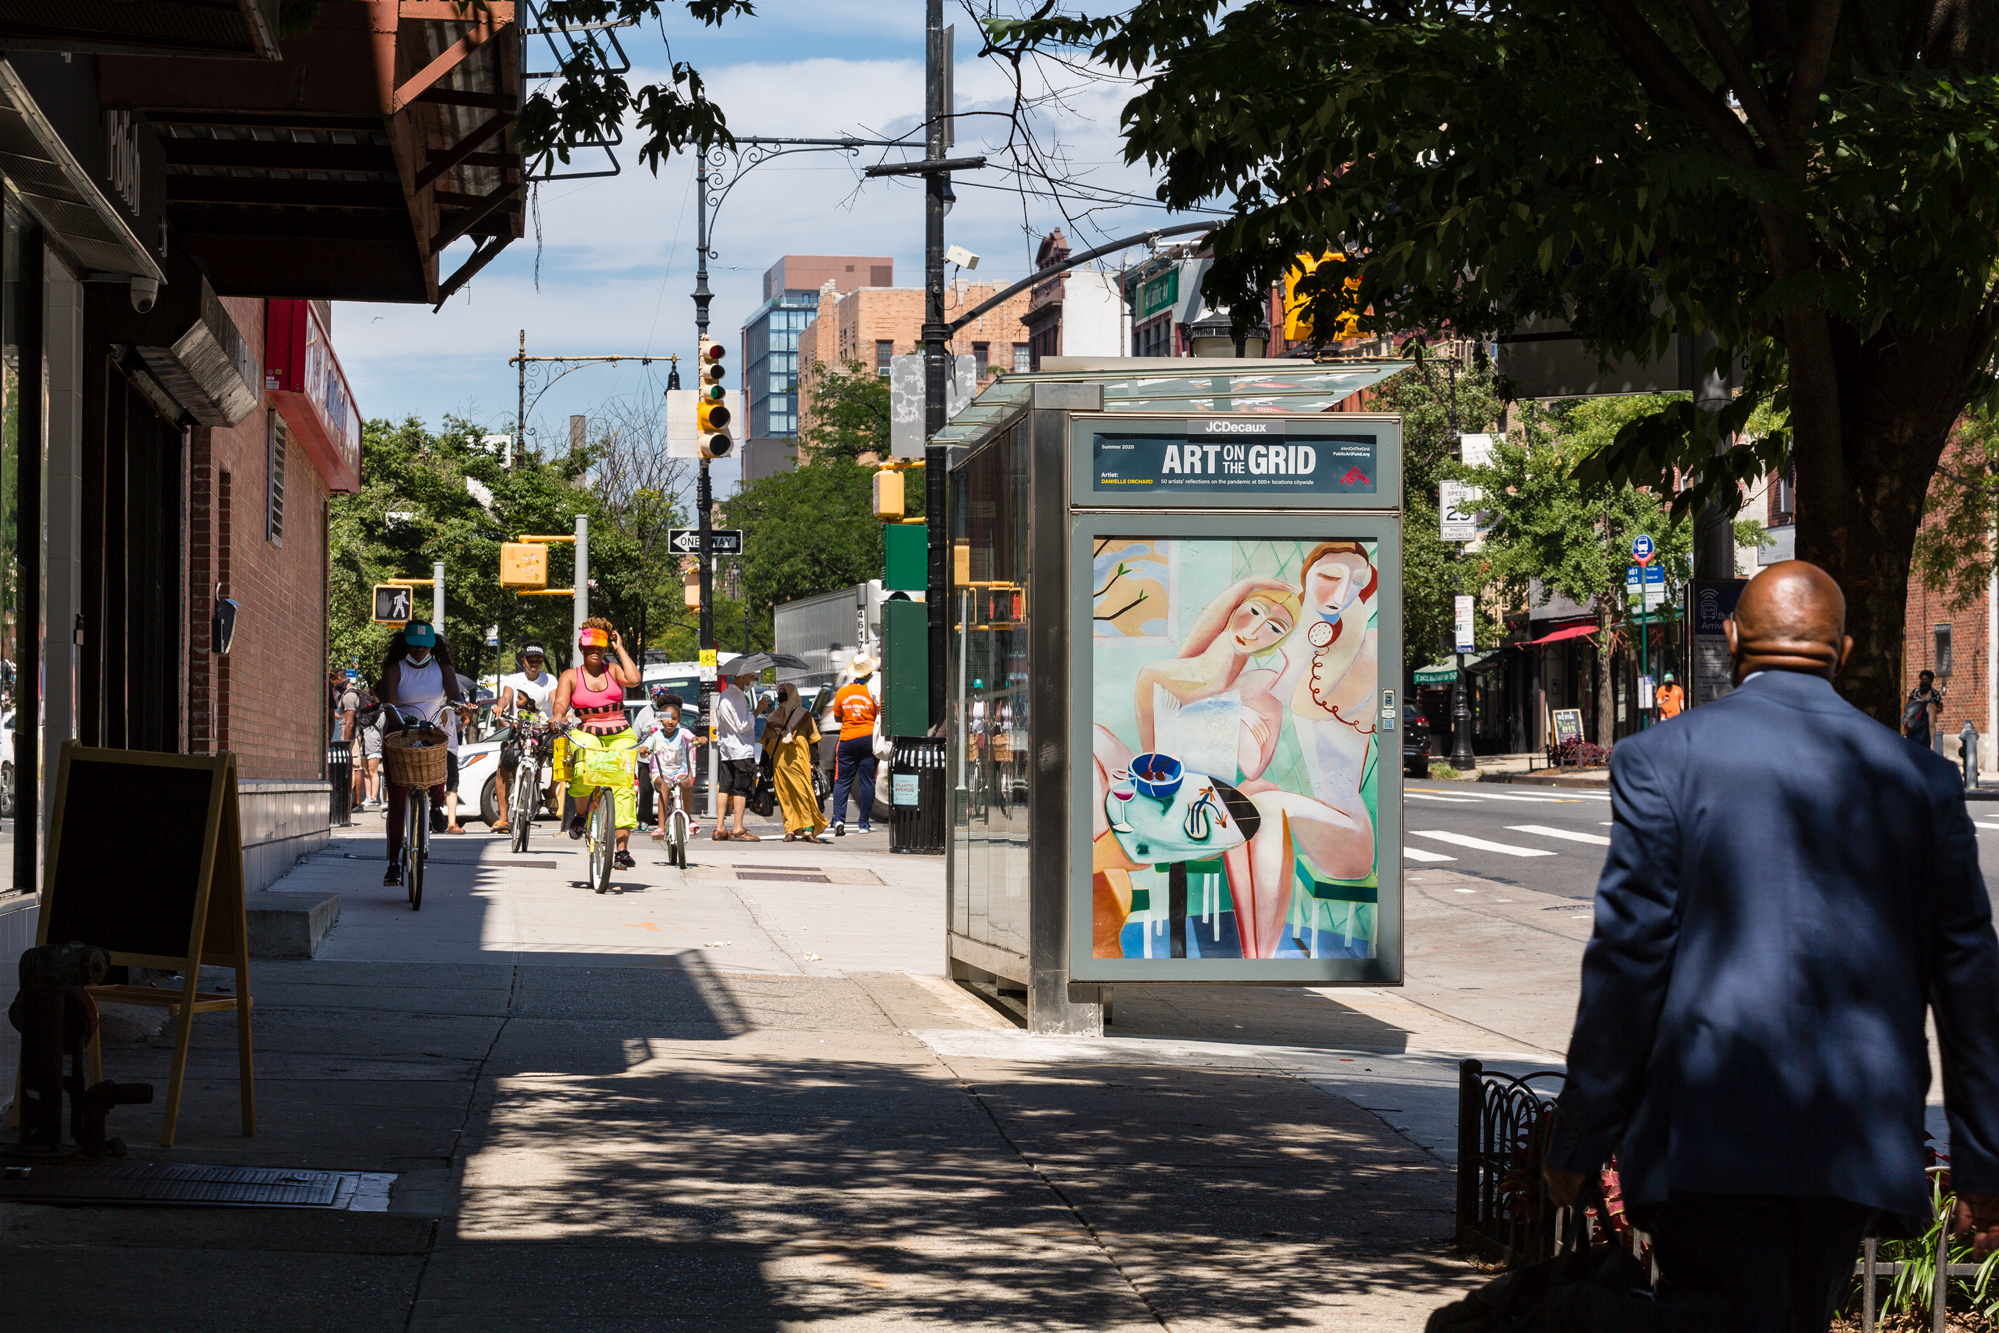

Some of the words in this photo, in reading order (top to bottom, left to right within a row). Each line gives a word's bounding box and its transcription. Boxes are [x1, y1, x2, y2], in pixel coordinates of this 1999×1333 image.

[1205, 421, 1266, 433] JCDecaux
[1161, 444, 1221, 474] ART
[1223, 445, 1245, 461] ON
[1248, 444, 1317, 475] GRID
[1222, 461, 1246, 474] THE
[1340, 465, 1359, 484] PUBLIC
[680, 536, 700, 547] ONE
[711, 537, 732, 547] WAY
[1718, 612, 1731, 620] Bu
[1701, 621, 1725, 630] Arriva
